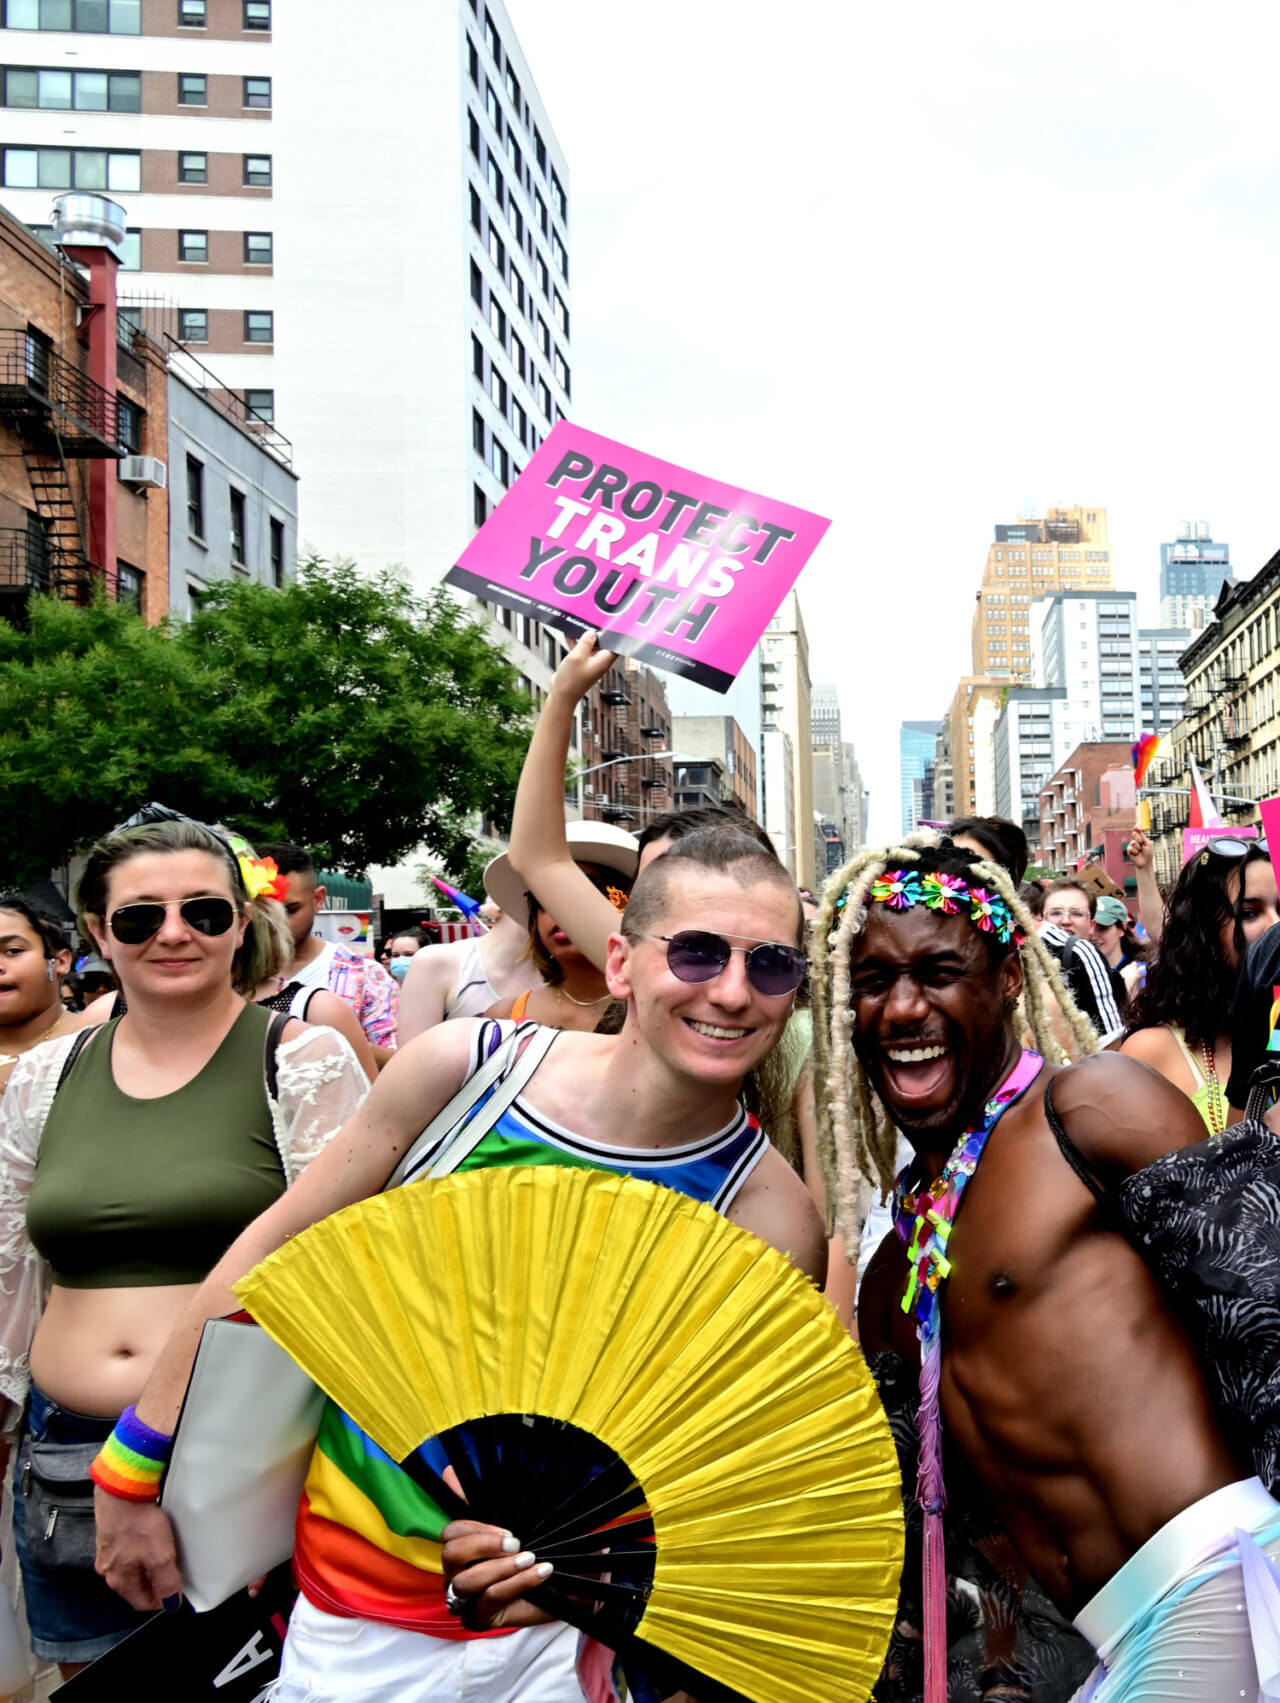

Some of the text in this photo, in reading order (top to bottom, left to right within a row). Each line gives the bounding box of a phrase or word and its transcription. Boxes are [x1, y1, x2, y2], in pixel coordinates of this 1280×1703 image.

[545, 449, 797, 565] PROTECT
[545, 497, 746, 599] TRANS
[519, 536, 718, 644] YOUTH
